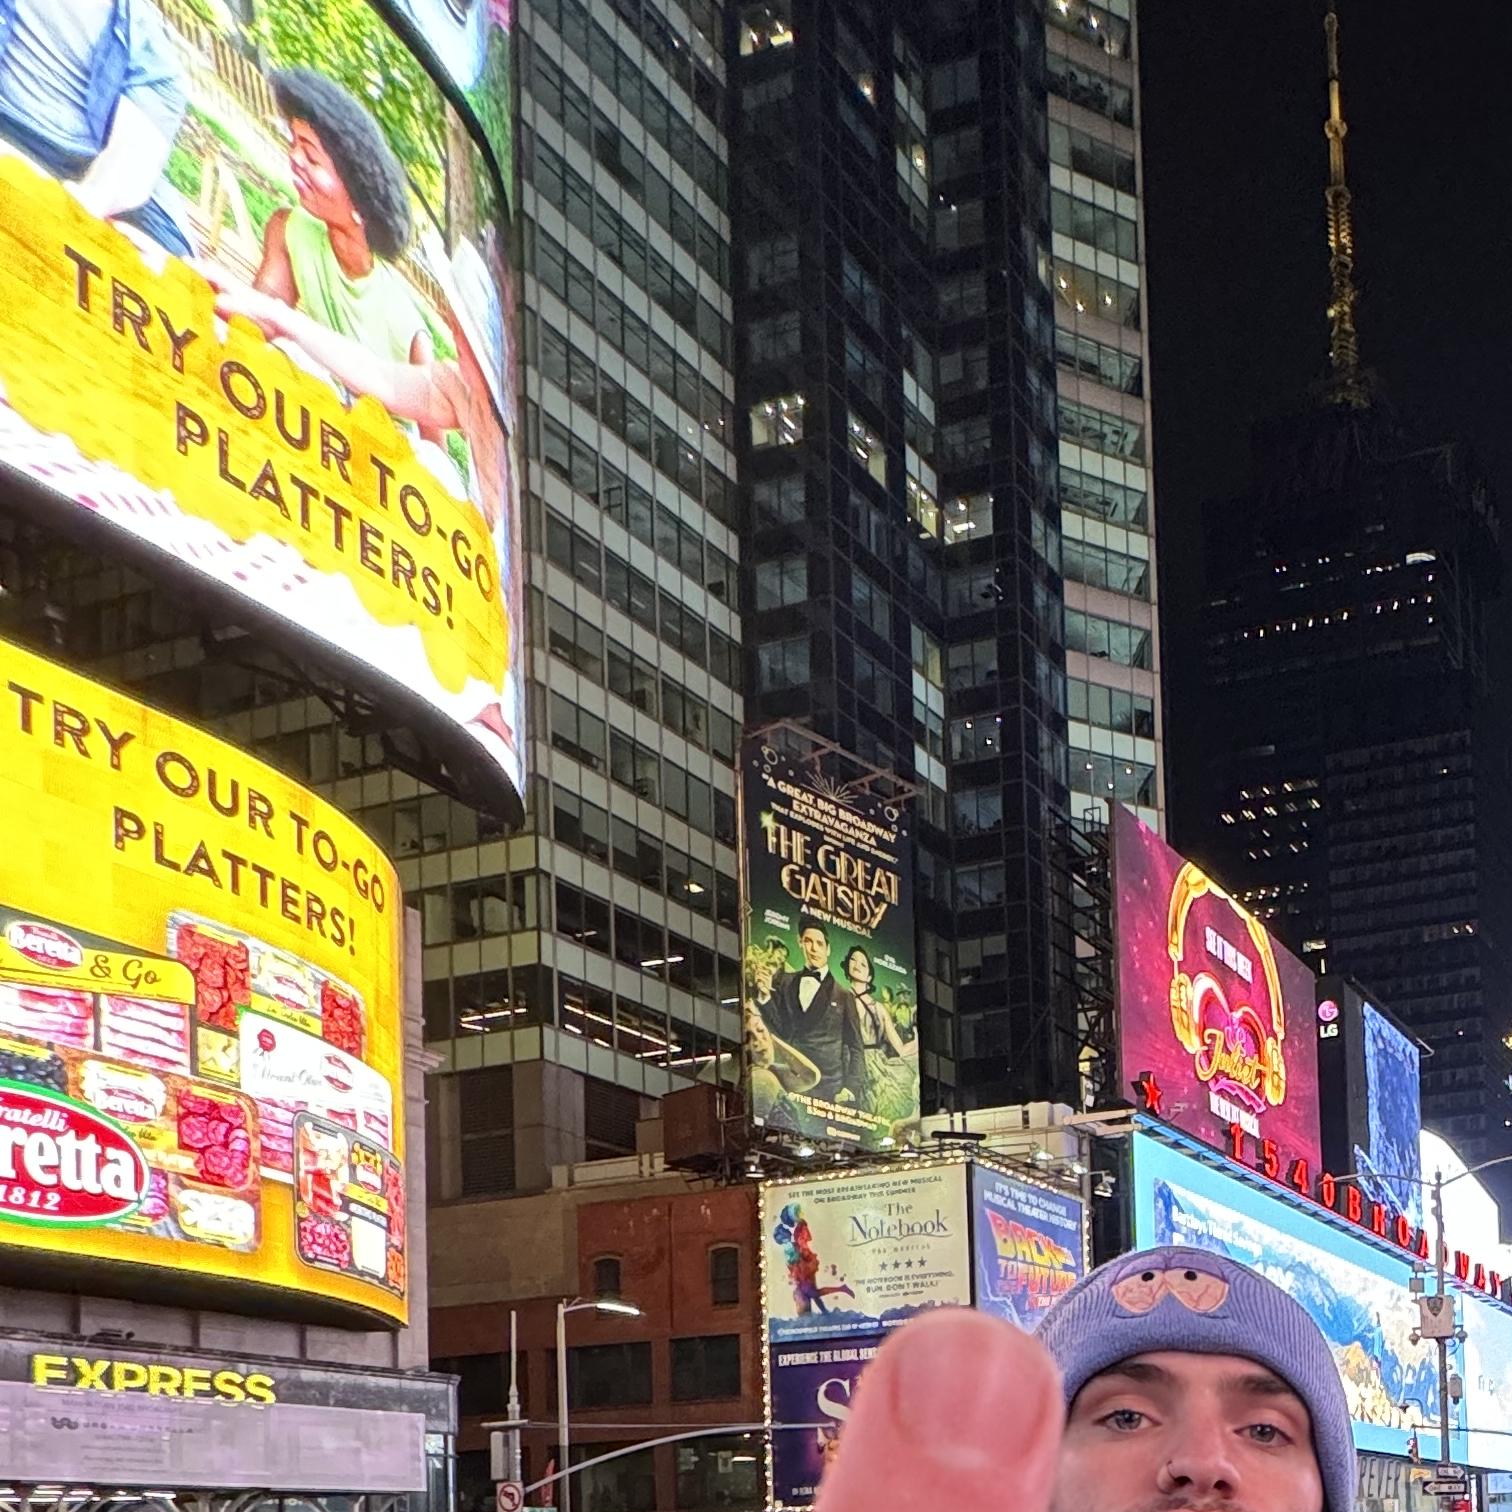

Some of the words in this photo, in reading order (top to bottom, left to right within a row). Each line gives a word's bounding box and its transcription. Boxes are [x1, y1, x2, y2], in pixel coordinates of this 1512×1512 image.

[64, 244, 198, 374] TRY
[219, 360, 352, 485] OUR
[369, 453, 495, 603] TO-GO
[175, 400, 456, 630] PLATTERS!
[7, 680, 136, 771] TRY
[155, 751, 276, 840] OUR
[289, 809, 385, 914] TO-GO
[792, 800, 878, 847] EXTRAVAGANZA
[838, 808, 897, 843] BROADWAY
[113, 805, 356, 957] PLATTERS!
[764, 814, 812, 869] THE
[817, 844, 901, 906] GREAT
[781, 864, 888, 929] GATSBY
[810, 907, 831, 922] NEW
[833, 916, 873, 939] MUSICAL
[122, 959, 162, 990] Go
[1319, 1023, 1338, 1039] LG
[1196, 1028, 1266, 1090] Juliet
[910, 1175, 943, 1185] MUSICAL
[1230, 1122, 1336, 1208] 1540
[1, 1185, 60, 1211] 1812
[885, 1202, 914, 1217] The
[983, 1189, 1017, 1211] MUSICAL
[848, 1208, 950, 1242] Notebook
[985, 1207, 1077, 1270] BACK
[32, 1353, 277, 1407] EXPRESS
